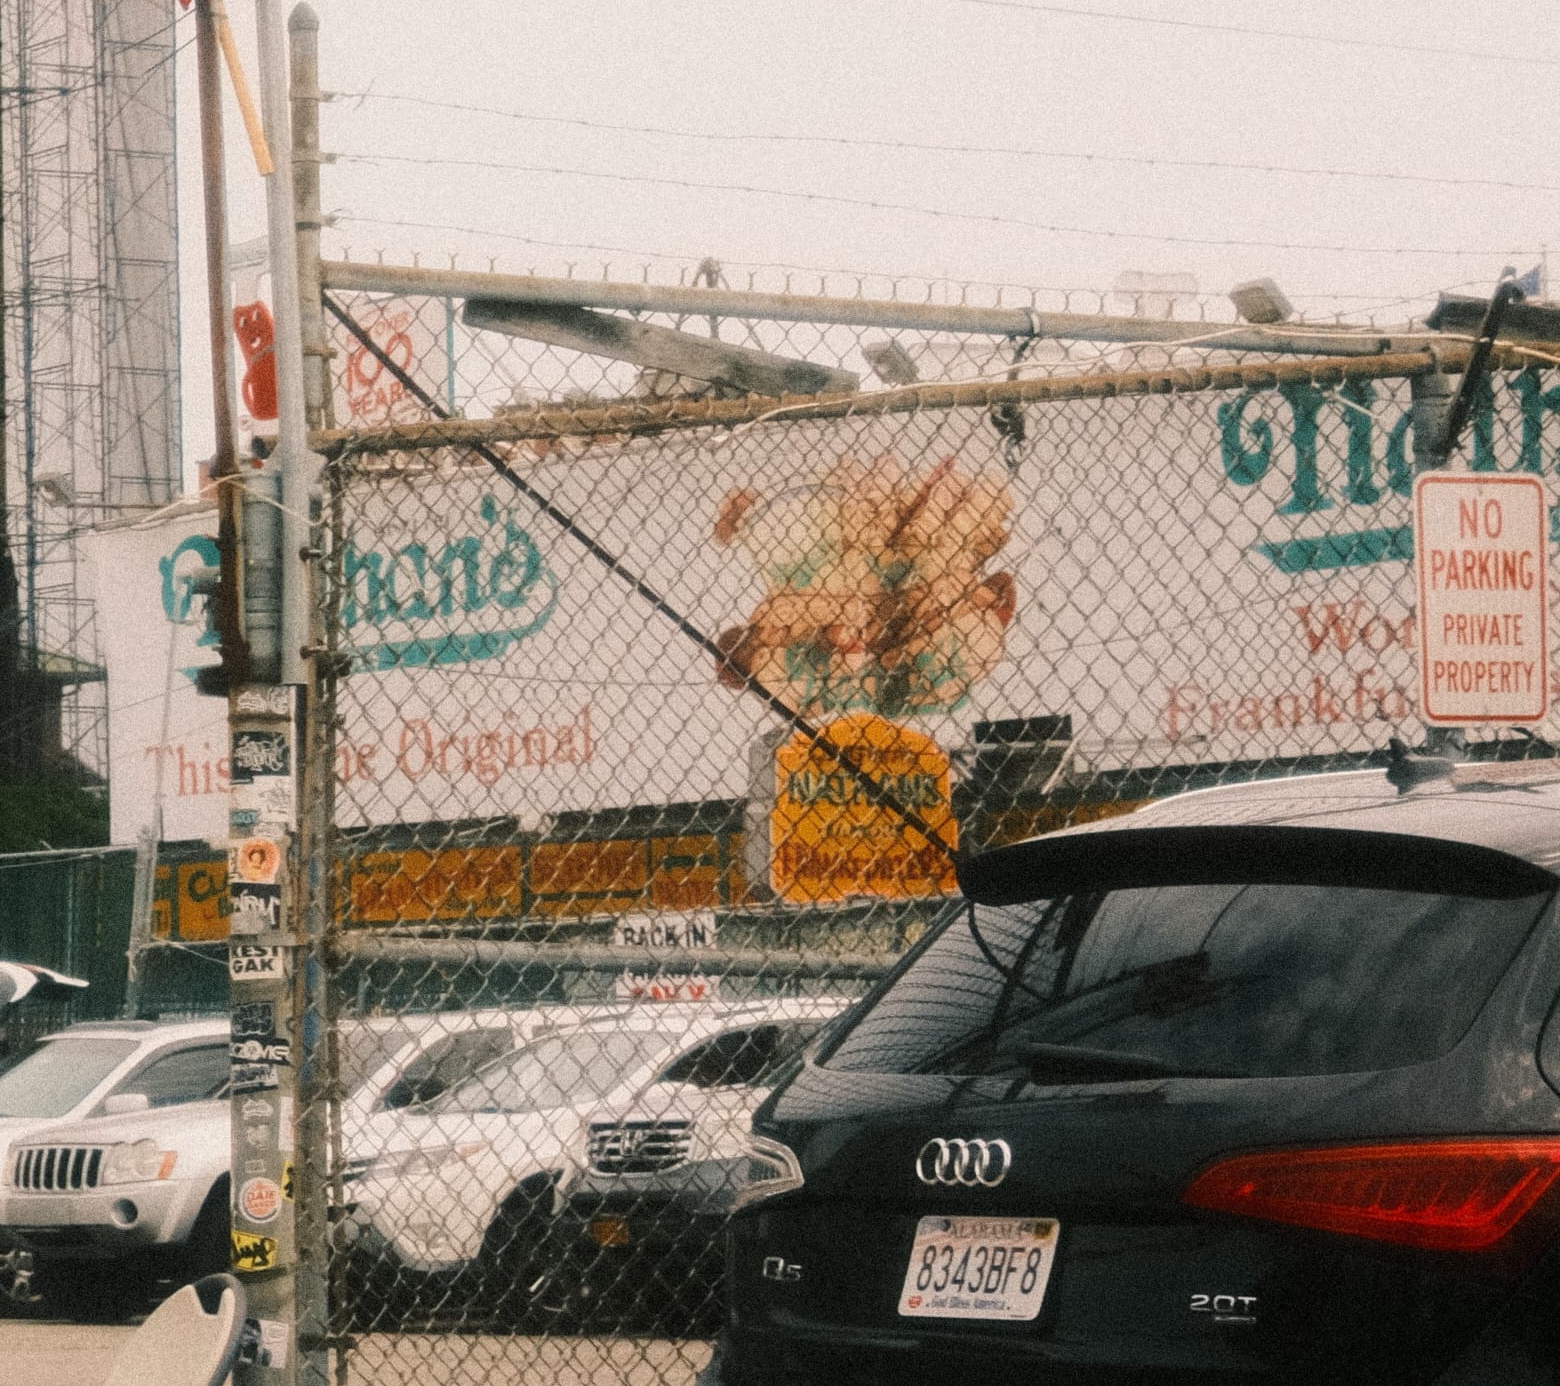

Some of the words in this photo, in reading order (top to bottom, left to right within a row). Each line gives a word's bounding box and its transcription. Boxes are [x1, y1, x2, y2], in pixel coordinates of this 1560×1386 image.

[1458, 499, 1504, 540] NO
[1431, 549, 1534, 591] PARKING
[1443, 614, 1524, 647] PRIVATE
[1433, 660, 1536, 694] PROPERTY
[399, 705, 597, 786] Original
[763, 1256, 803, 1281] Q5
[916, 1244, 1042, 1295] 8343BF8
